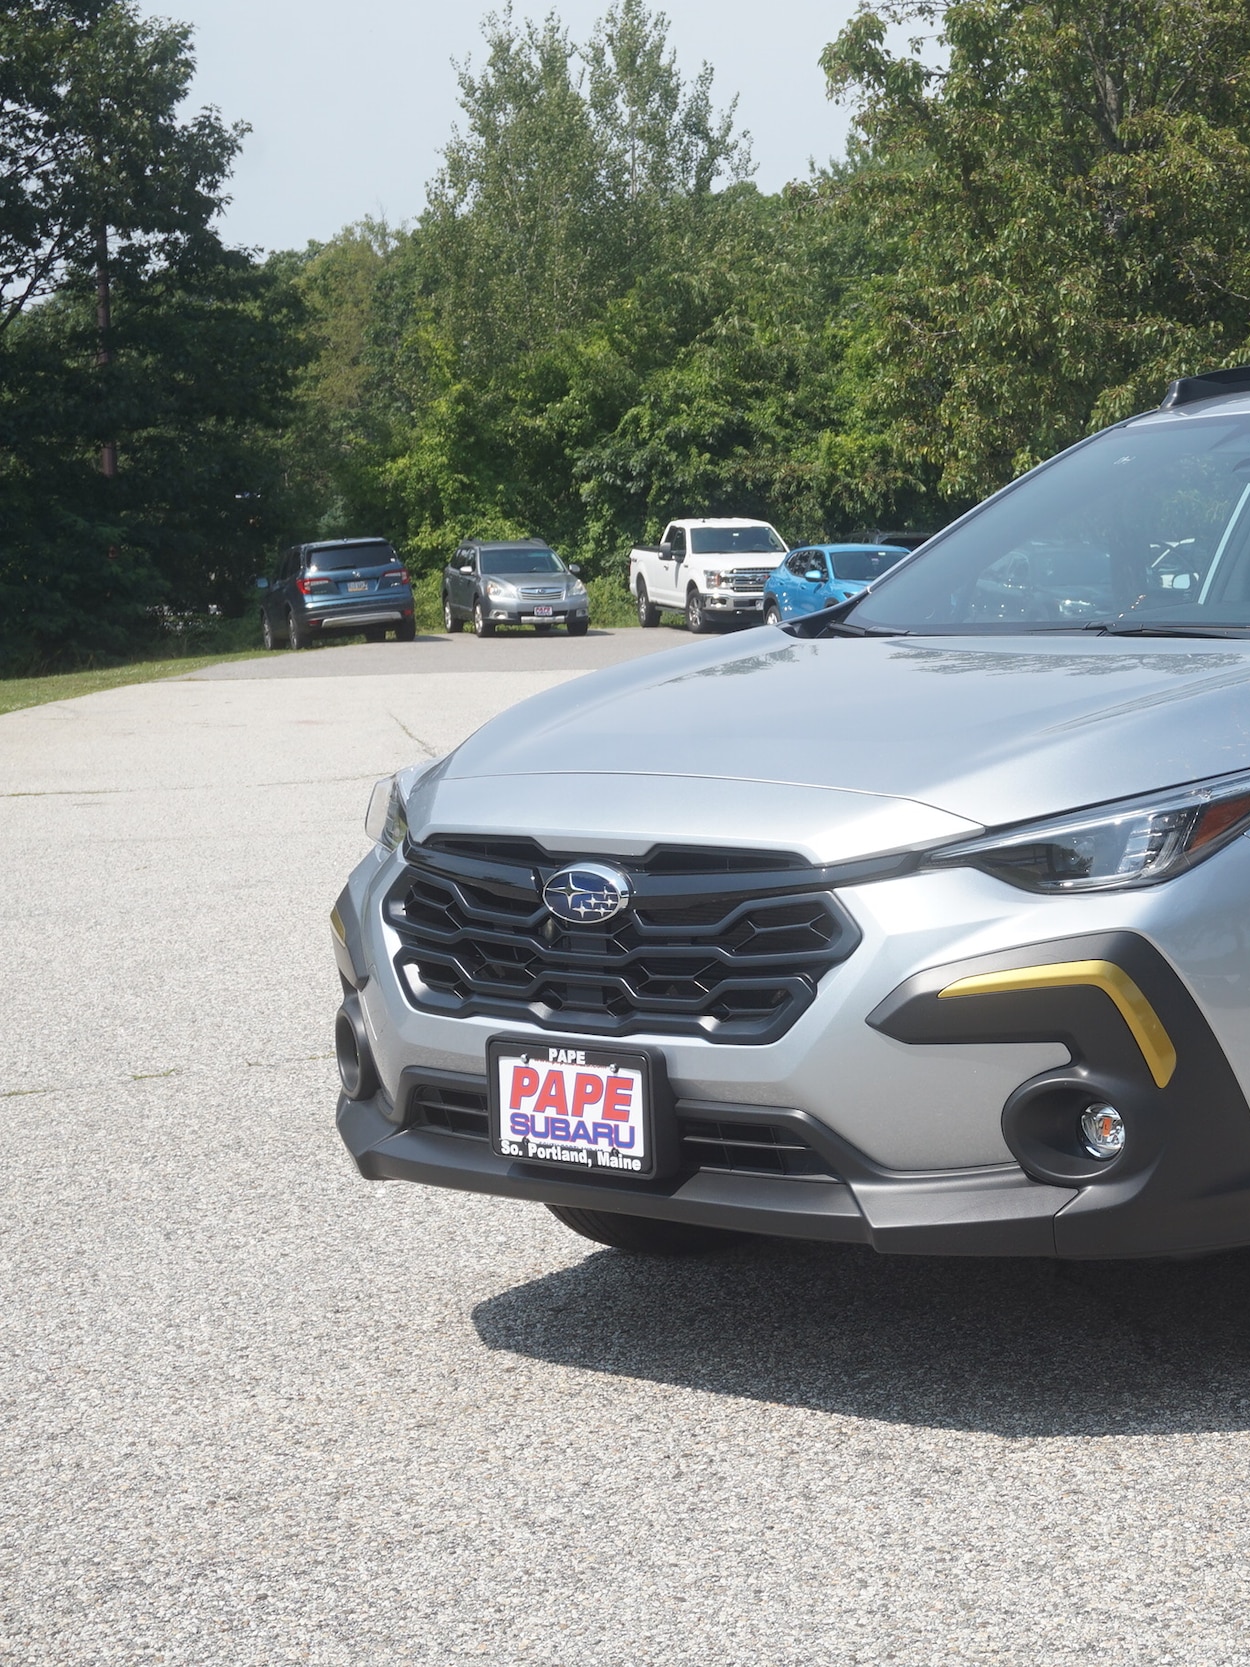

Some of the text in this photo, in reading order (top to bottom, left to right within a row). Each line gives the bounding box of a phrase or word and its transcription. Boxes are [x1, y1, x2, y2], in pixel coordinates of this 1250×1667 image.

[548, 1048, 586, 1064] PAPE
[509, 1065, 634, 1122] PAPE
[509, 1112, 635, 1149] SUBARU
[500, 1140, 523, 1157] So.
[528, 1143, 592, 1167] Portland,
[597, 1153, 642, 1171] Maine
